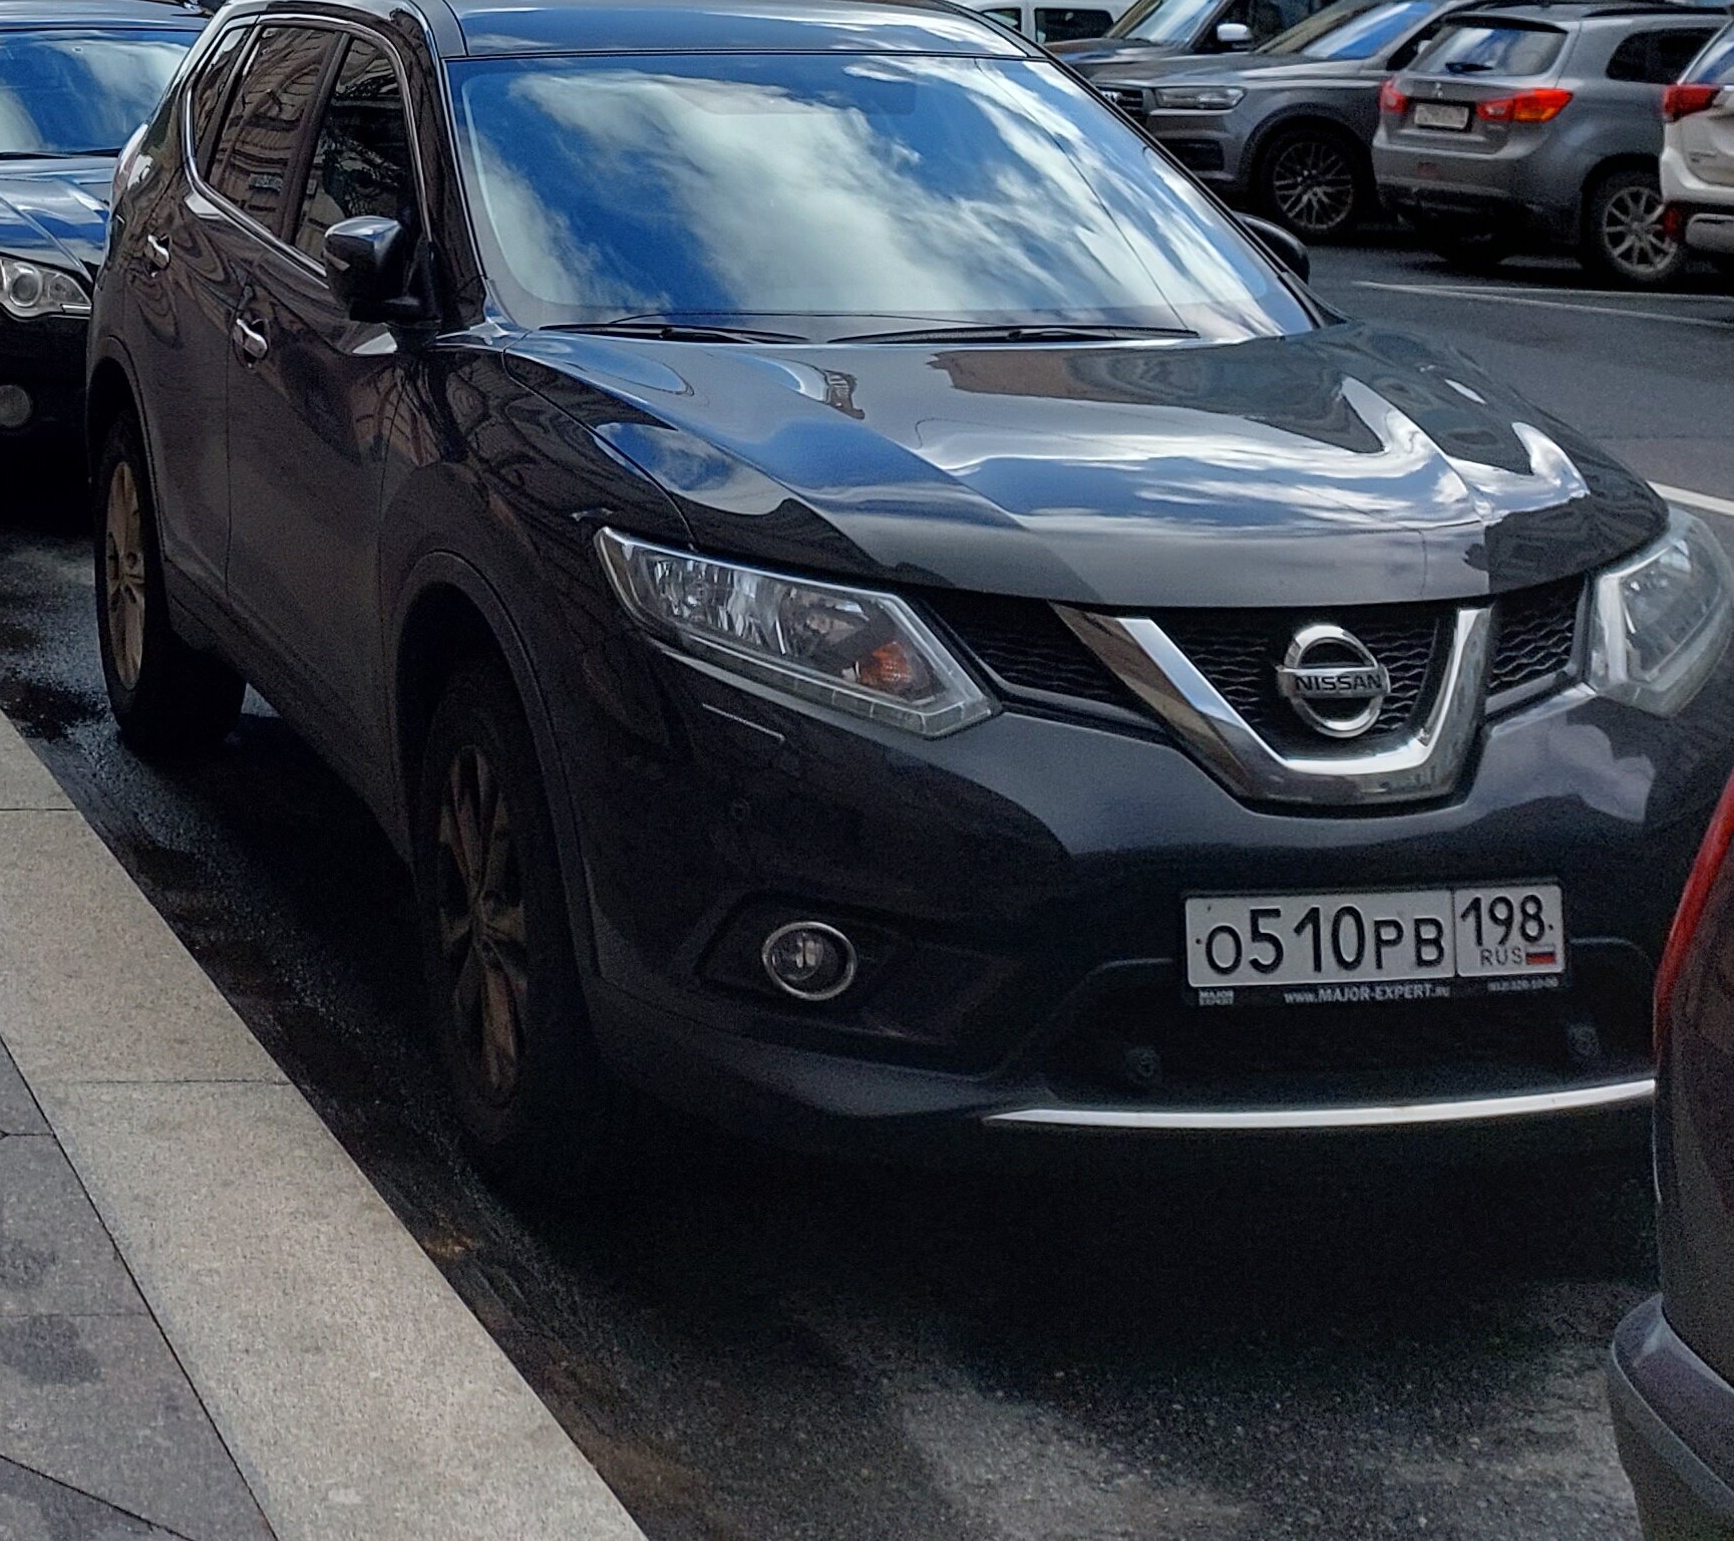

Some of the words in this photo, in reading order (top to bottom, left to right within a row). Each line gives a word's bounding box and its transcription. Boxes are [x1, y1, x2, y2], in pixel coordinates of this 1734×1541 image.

[1294, 673, 1383, 692] NISSAN
[1204, 903, 1446, 976] О510РВ
[1460, 893, 1547, 948] 198
[1479, 946, 1523, 967] RUS
